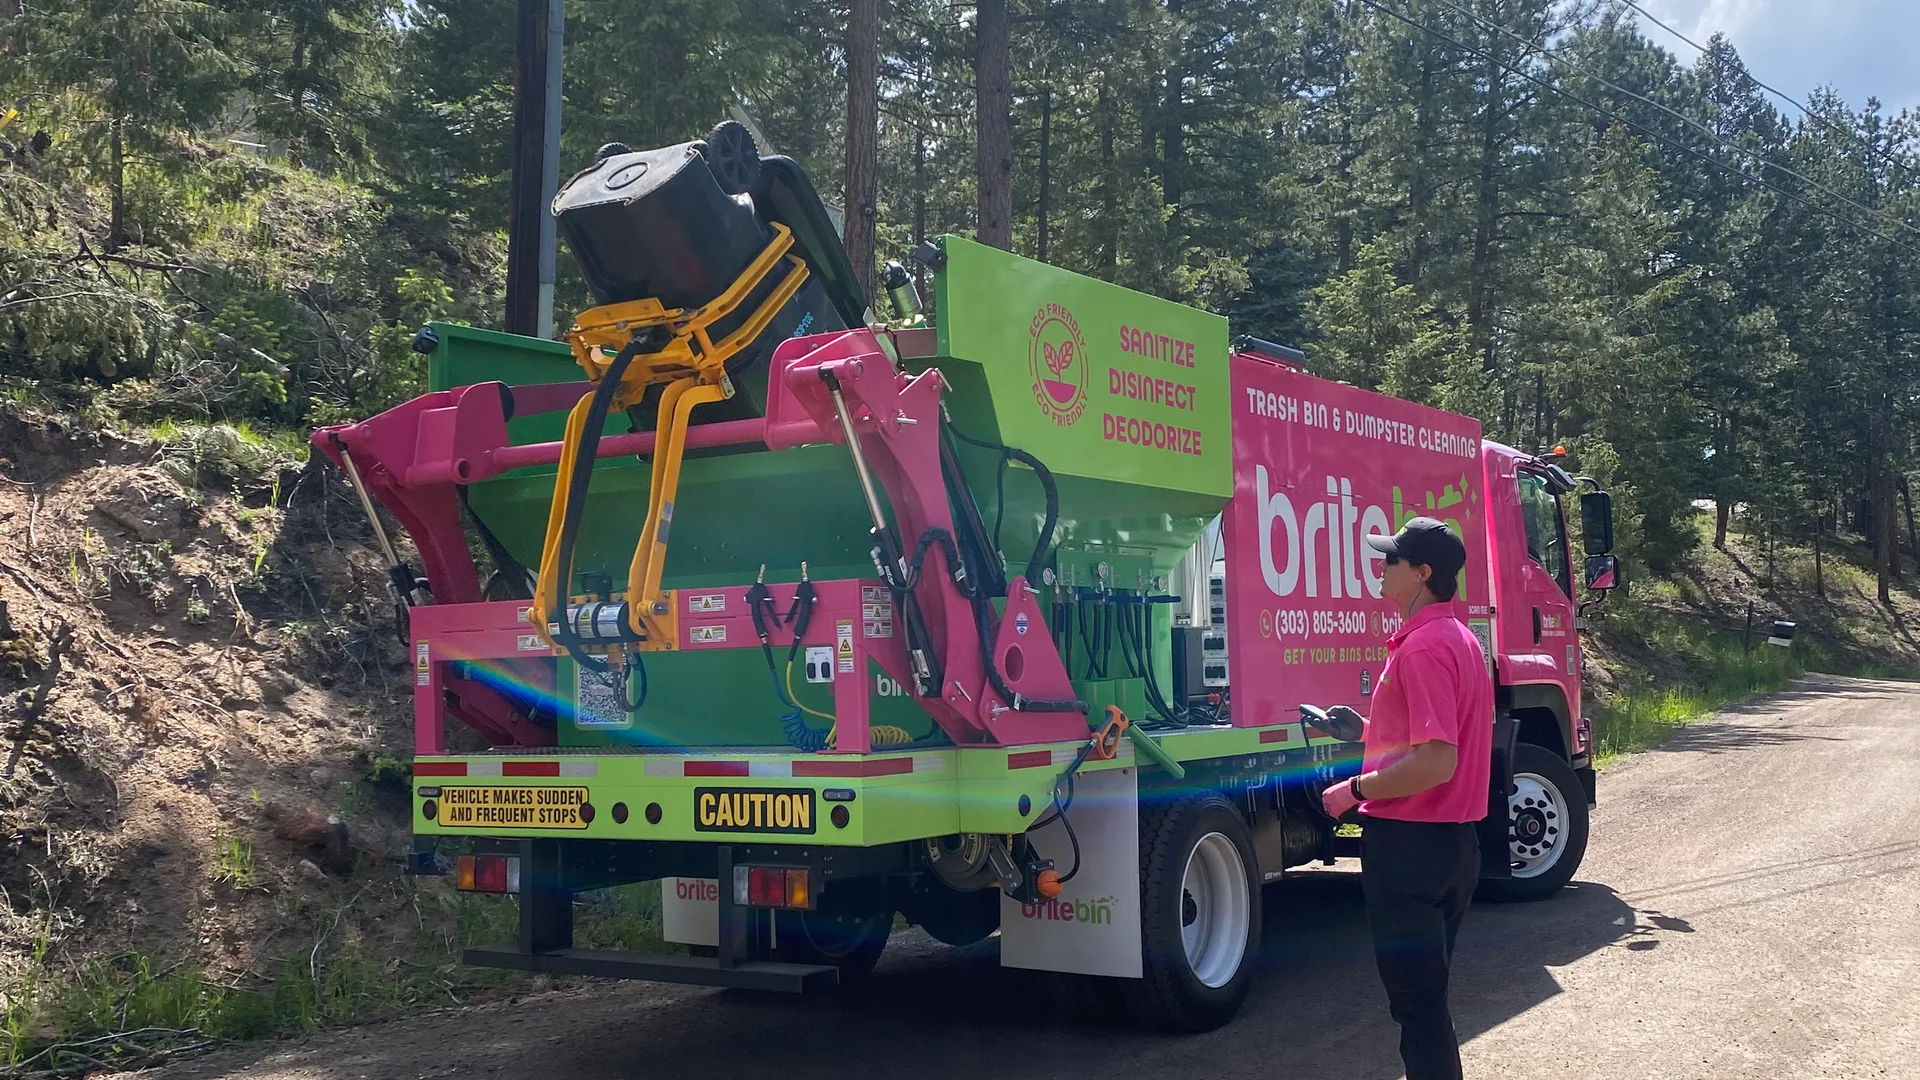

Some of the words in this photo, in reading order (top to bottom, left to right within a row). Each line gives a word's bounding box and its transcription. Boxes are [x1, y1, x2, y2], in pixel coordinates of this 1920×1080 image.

[1029, 308, 1045, 338] ECO
[1046, 302, 1087, 347] FRIENDLY
[1119, 324, 1196, 369] SANITIZE
[1031, 382, 1050, 416] ECO
[1051, 386, 1089, 427] FRIENDLY
[1108, 367, 1196, 412] DISINFECT
[1102, 412, 1203, 457] DEODORIZE
[1246, 387, 1298, 423] TRASH
[1303, 401, 1328, 430] BIN
[1332, 407, 1341, 432] &
[1346, 410, 1416, 448] DUMPSTER
[1418, 426, 1477, 460] CLEANING
[1274, 609, 1310, 642] (303)
[1312, 610, 1367, 635] 805-3600
[1283, 648, 1306, 665] GET
[1309, 647, 1336, 664] YOUR
[1339, 646, 1362, 663] BINS
[1364, 646, 1389, 662] CLEA
[443, 788, 489, 804] VEHICLE
[493, 789, 533, 805] MAKES
[536, 789, 583, 805] SUDDEN
[450, 806, 472, 822] AND
[476, 807, 535, 824] FREQUENT
[539, 808, 577, 824] STOPS
[700, 793, 810, 828] CAUTION
